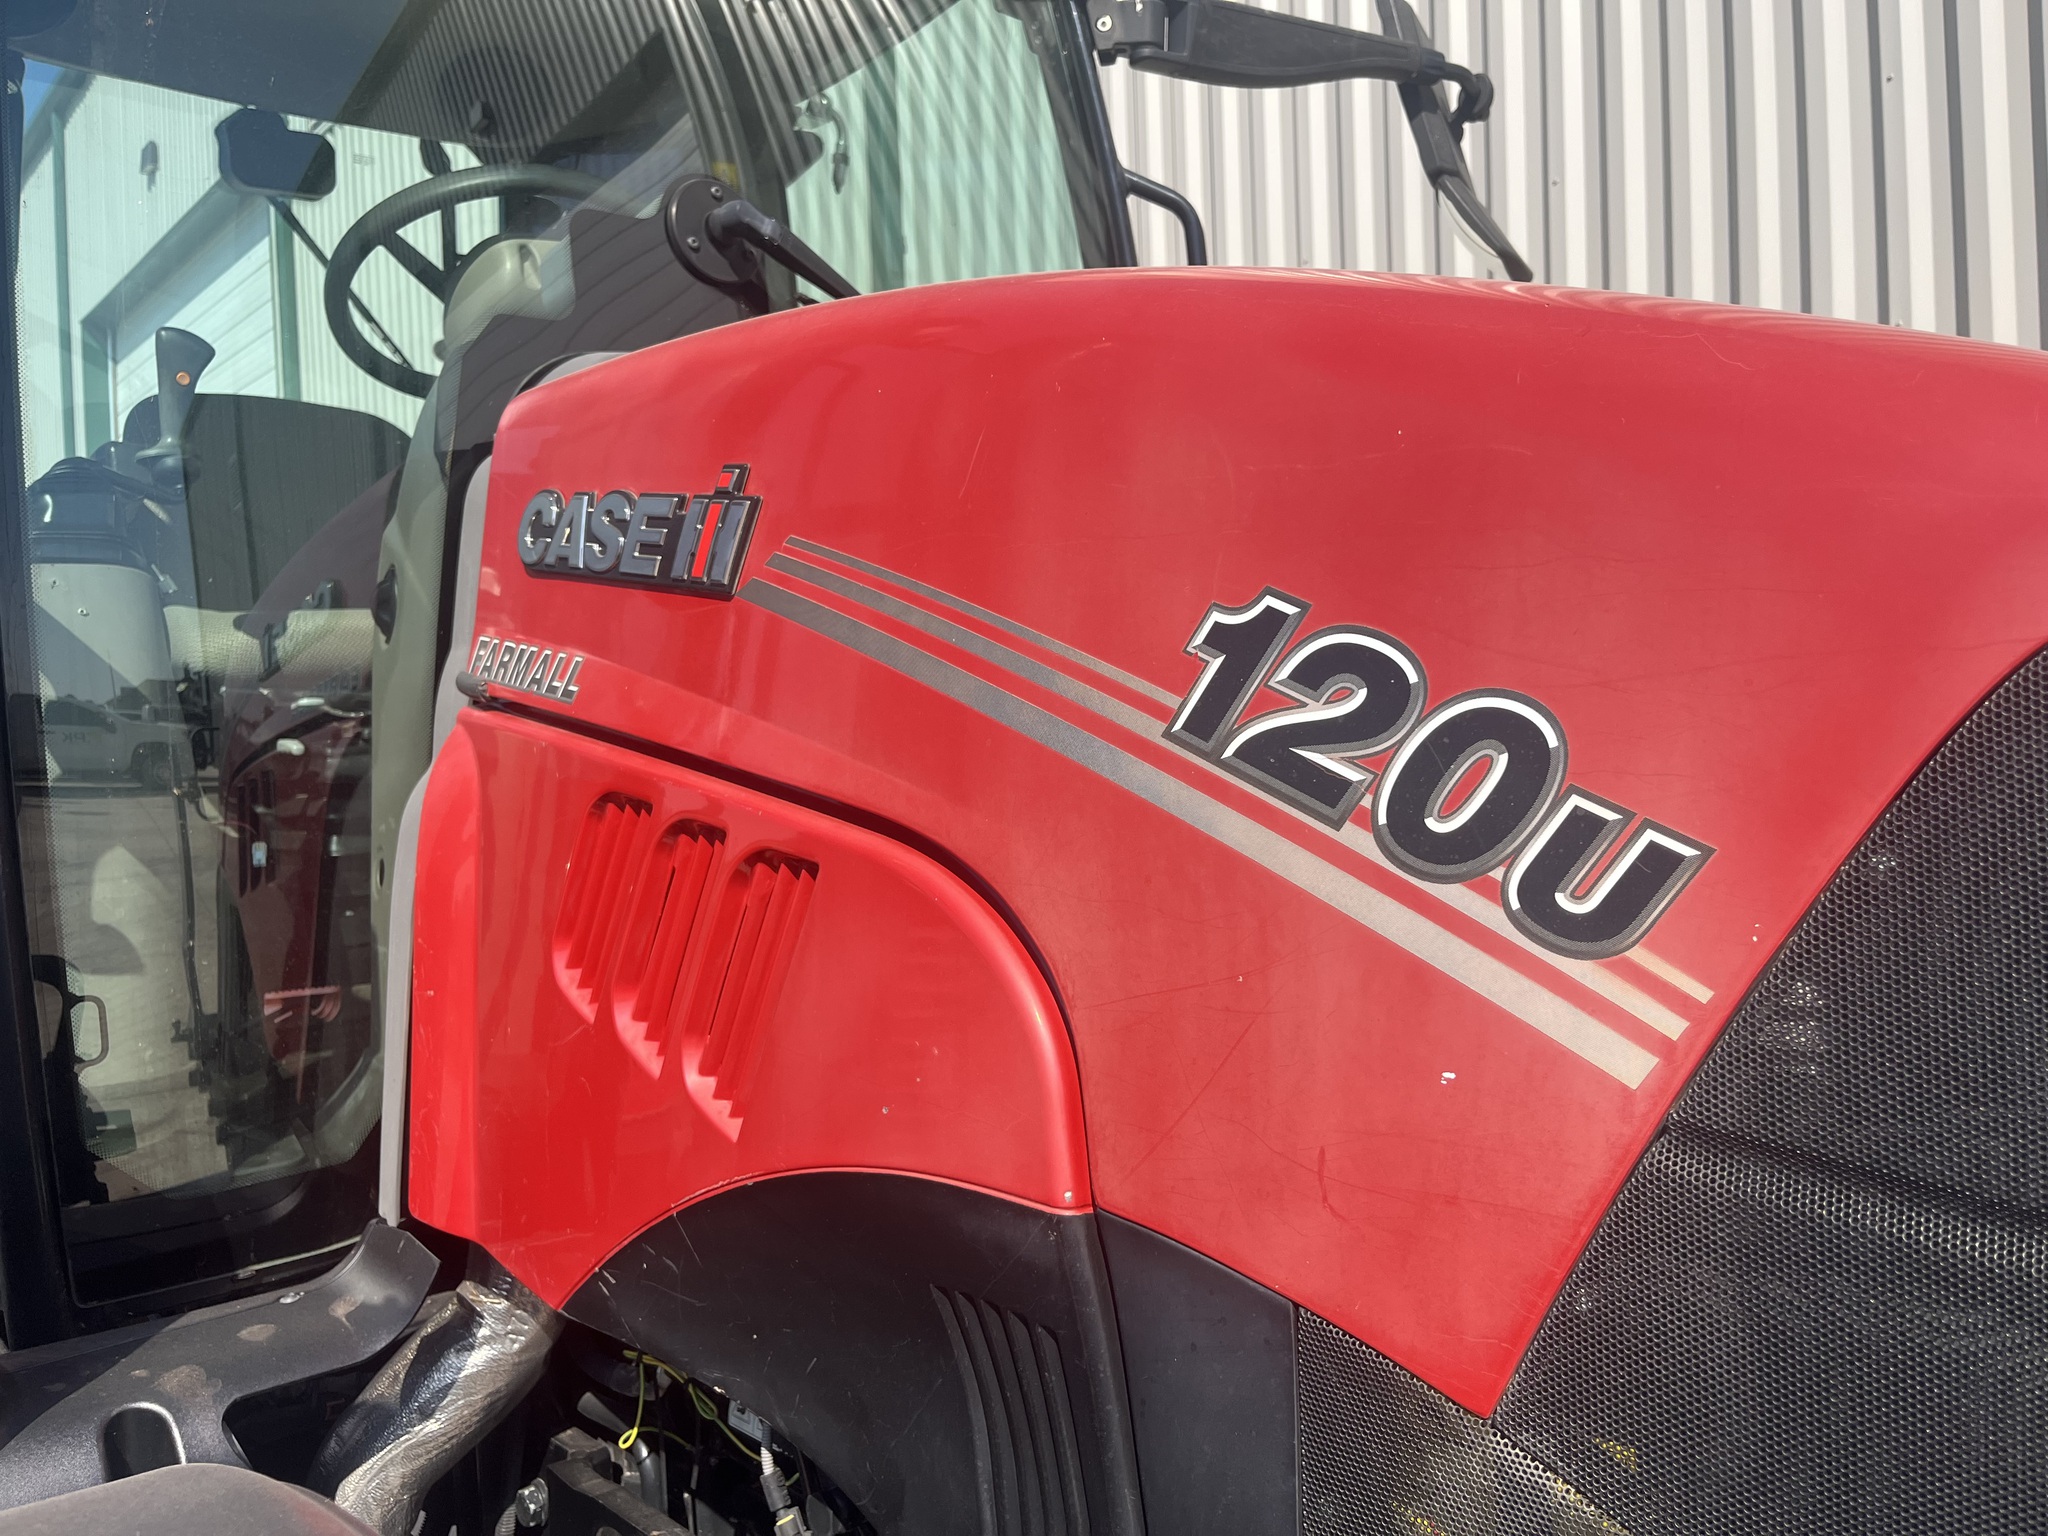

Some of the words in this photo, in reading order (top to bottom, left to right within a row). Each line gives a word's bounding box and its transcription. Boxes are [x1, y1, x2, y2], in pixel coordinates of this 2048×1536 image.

[518, 489, 683, 577] CASE
[469, 635, 585, 704] FARMALL
[1162, 586, 1716, 960] 120U
